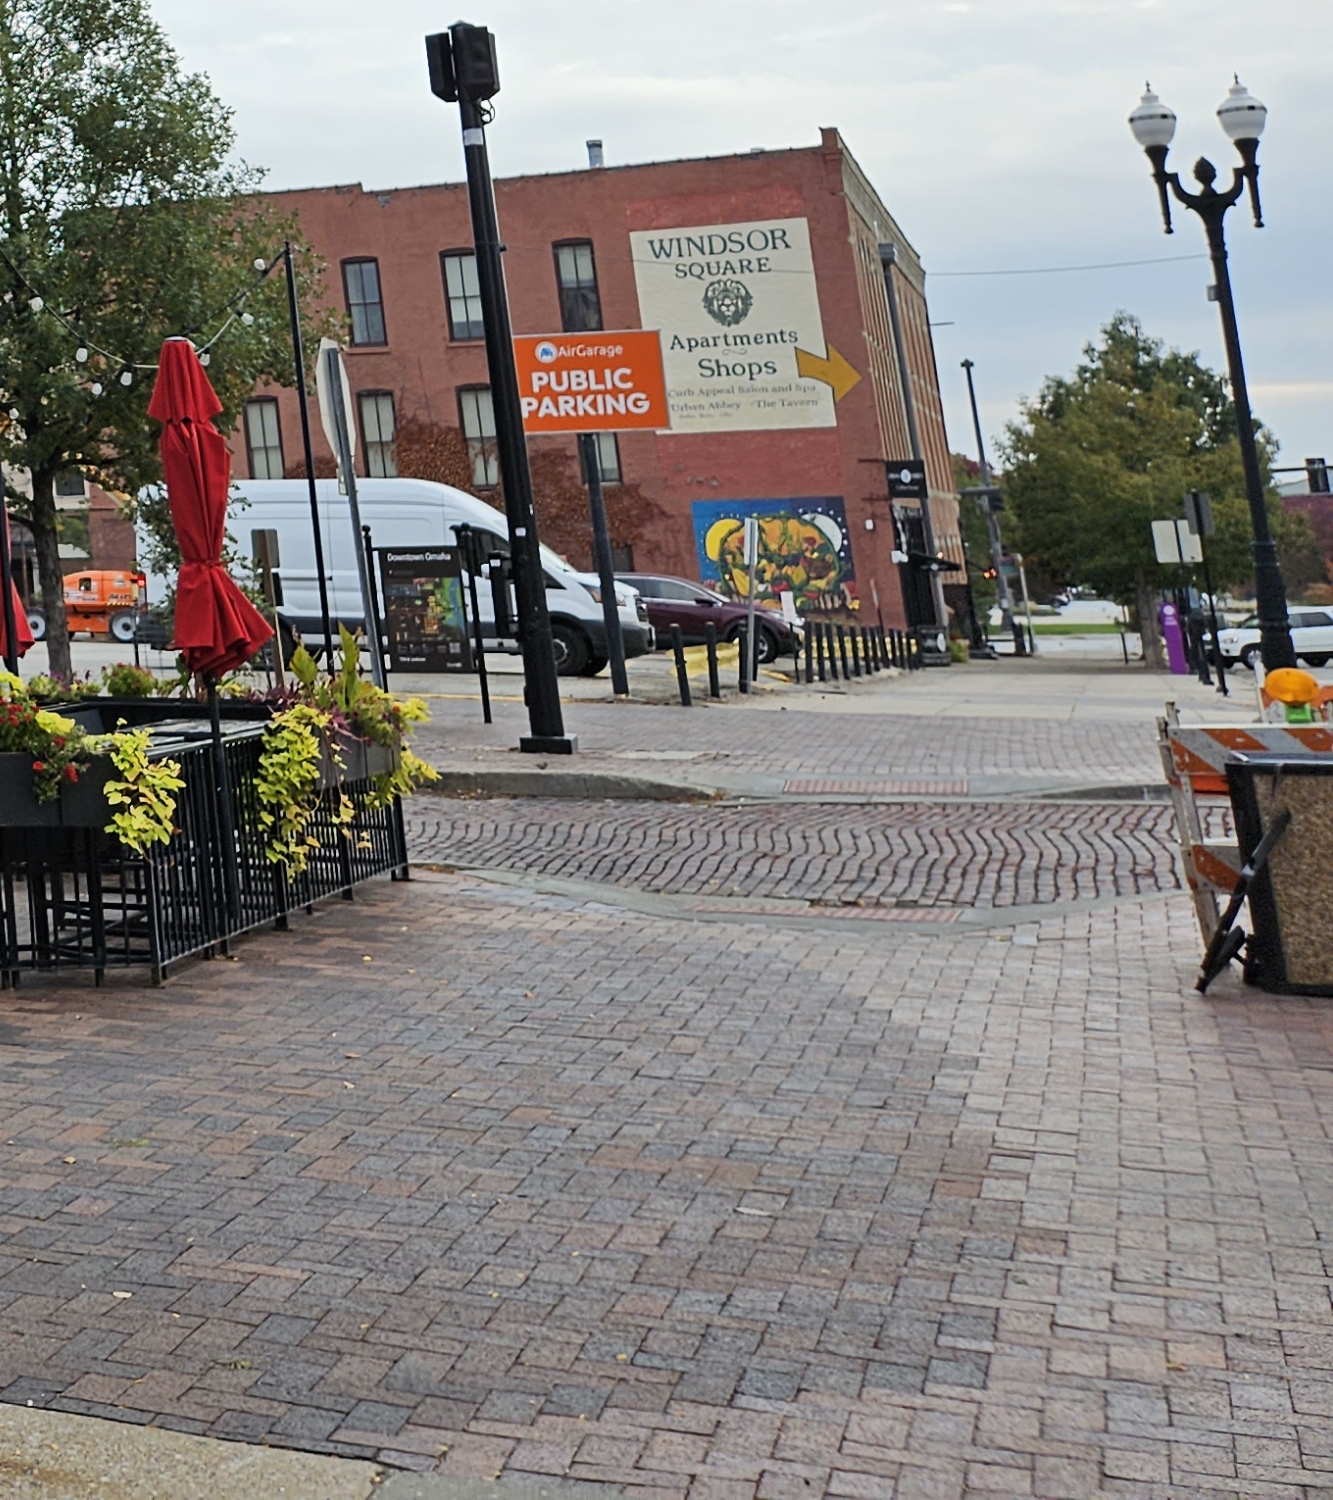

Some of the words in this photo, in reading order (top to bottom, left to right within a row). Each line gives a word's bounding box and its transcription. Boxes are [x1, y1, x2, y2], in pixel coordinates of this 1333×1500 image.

[648, 228, 792, 259] WINDSOR
[675, 257, 772, 280] SQUARE
[557, 344, 623, 357] AirGarage
[670, 329, 798, 352] Apartments
[531, 367, 634, 393] PUBLIC
[698, 358, 777, 380] Shops
[698, 385, 735, 398] Appeal
[738, 385, 769, 395] Salon
[771, 383, 793, 393] and
[795, 383, 817, 393] Spa
[520, 391, 651, 418] PARKING
[670, 402, 706, 412] Urban
[707, 401, 742, 411] Abbey
[756, 400, 777, 408] The
[780, 399, 819, 408] Tavern
